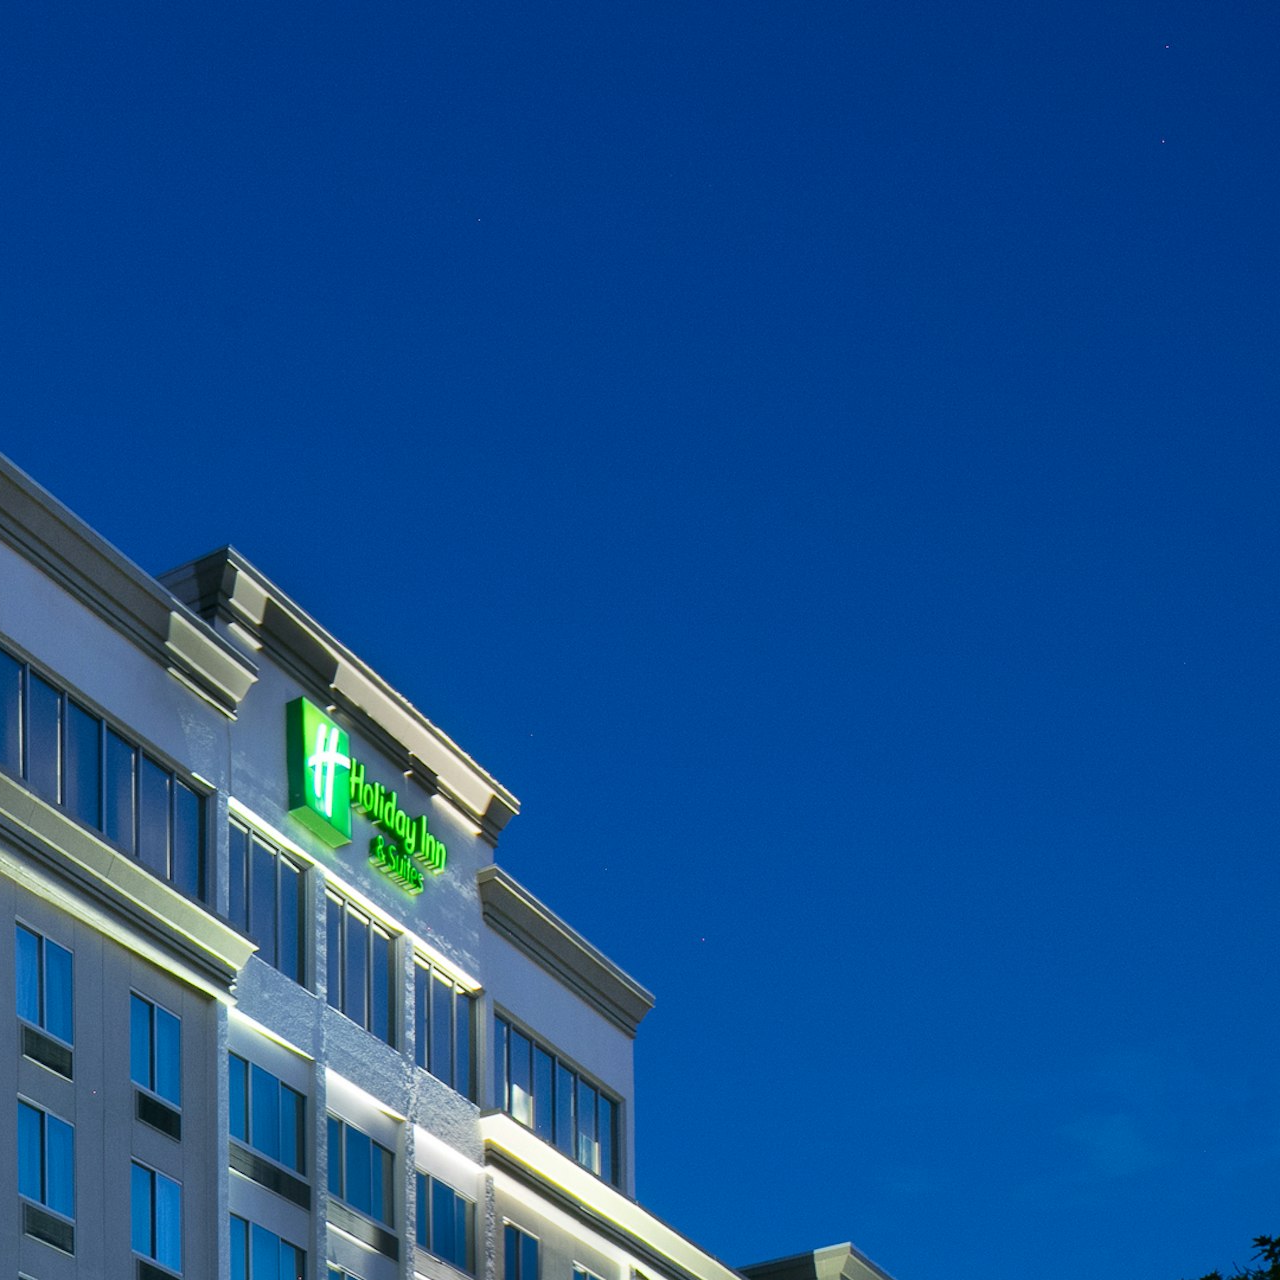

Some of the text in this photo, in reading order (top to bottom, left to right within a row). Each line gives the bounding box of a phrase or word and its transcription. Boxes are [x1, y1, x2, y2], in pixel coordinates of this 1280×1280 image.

[349, 757, 447, 871] Holiday Inn
[376, 834, 424, 889] & Suites
